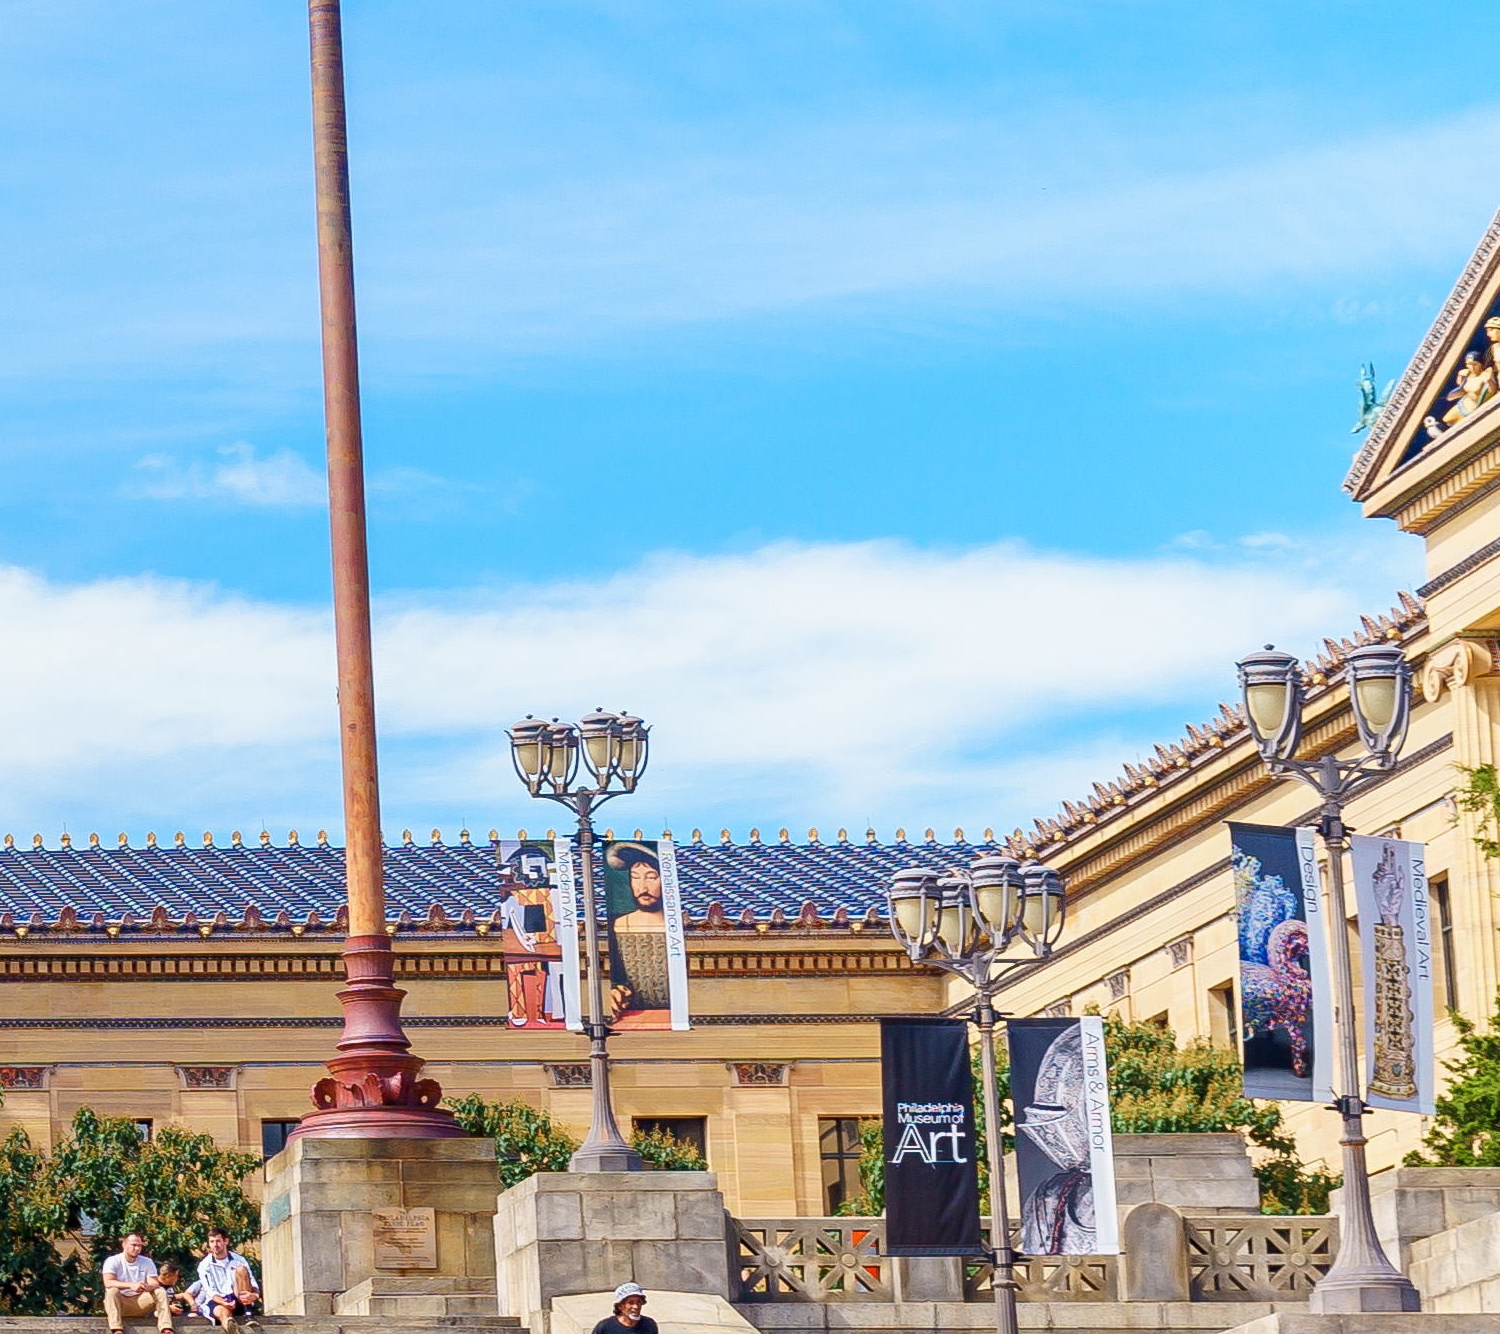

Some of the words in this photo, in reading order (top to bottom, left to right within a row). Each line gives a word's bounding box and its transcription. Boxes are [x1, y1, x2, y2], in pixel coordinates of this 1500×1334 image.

[557, 851, 572, 905] Modern
[661, 851, 678, 933] Renaissance
[1300, 846, 1318, 914] Design
[563, 907, 574, 929] Art
[1411, 859, 1430, 946] Medieval
[669, 935, 681, 958] Art
[1417, 949, 1430, 981] Art
[1085, 1032, 1100, 1076] Arms
[1088, 1081, 1104, 1094] &
[897, 1102, 965, 1116] Philadelphia
[897, 1113, 951, 1124] Museum
[953, 1113, 965, 1124] of
[1090, 1098, 1106, 1153] Armor
[891, 1124, 968, 1164] Art
